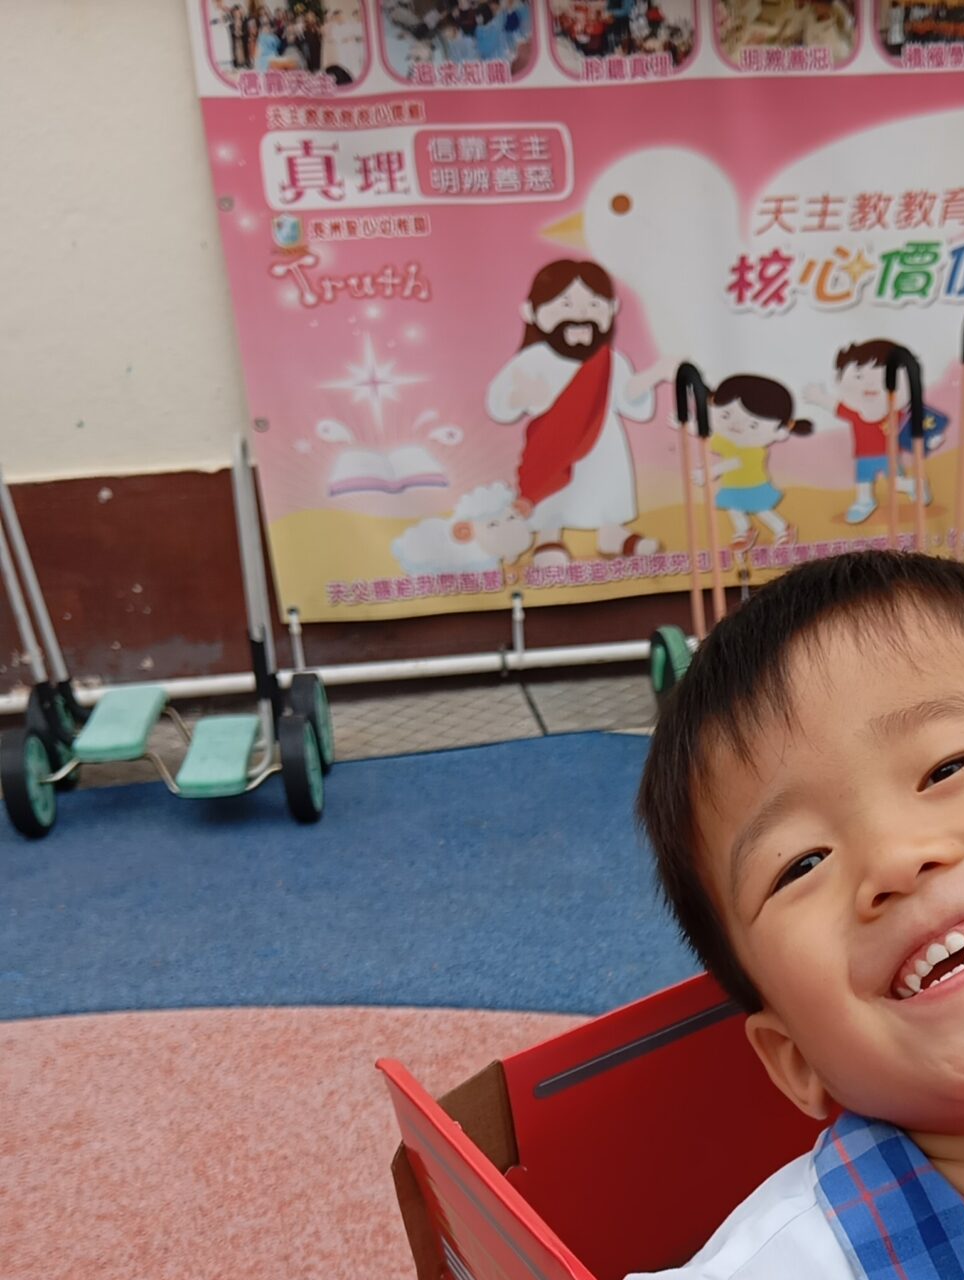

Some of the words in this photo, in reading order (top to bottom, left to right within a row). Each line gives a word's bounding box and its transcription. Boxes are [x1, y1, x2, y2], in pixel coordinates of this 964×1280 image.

[427, 135, 552, 164] 信靠天主
[273, 139, 412, 205] 真理
[429, 166, 554, 194] 明辨善惡
[271, 255, 431, 307] Truth
